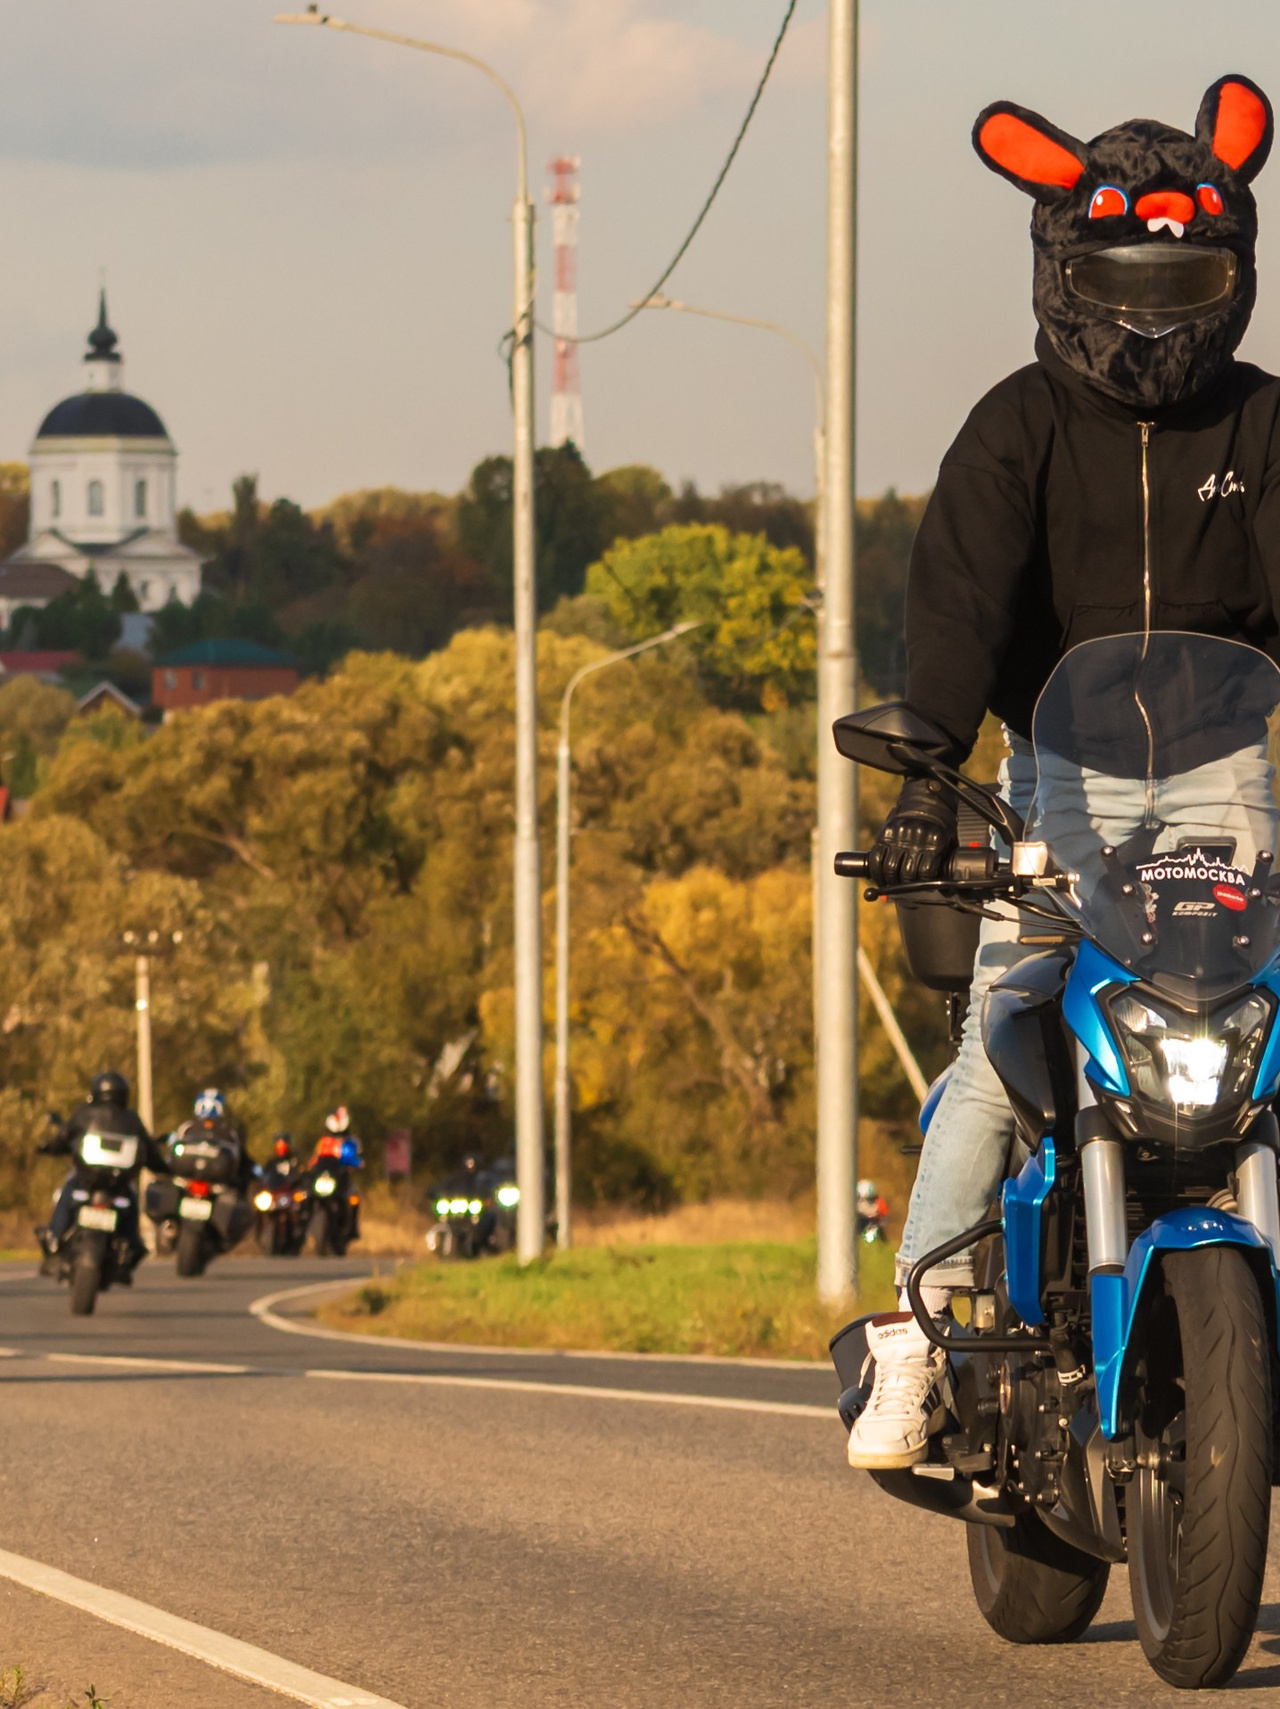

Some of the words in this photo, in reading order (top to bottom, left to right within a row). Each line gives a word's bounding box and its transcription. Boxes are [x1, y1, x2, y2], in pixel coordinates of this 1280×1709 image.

[1141, 867, 1245, 885] МОТОМОСКВА
[1174, 901, 1215, 911] GP
[878, 1328, 908, 1339] adidas
